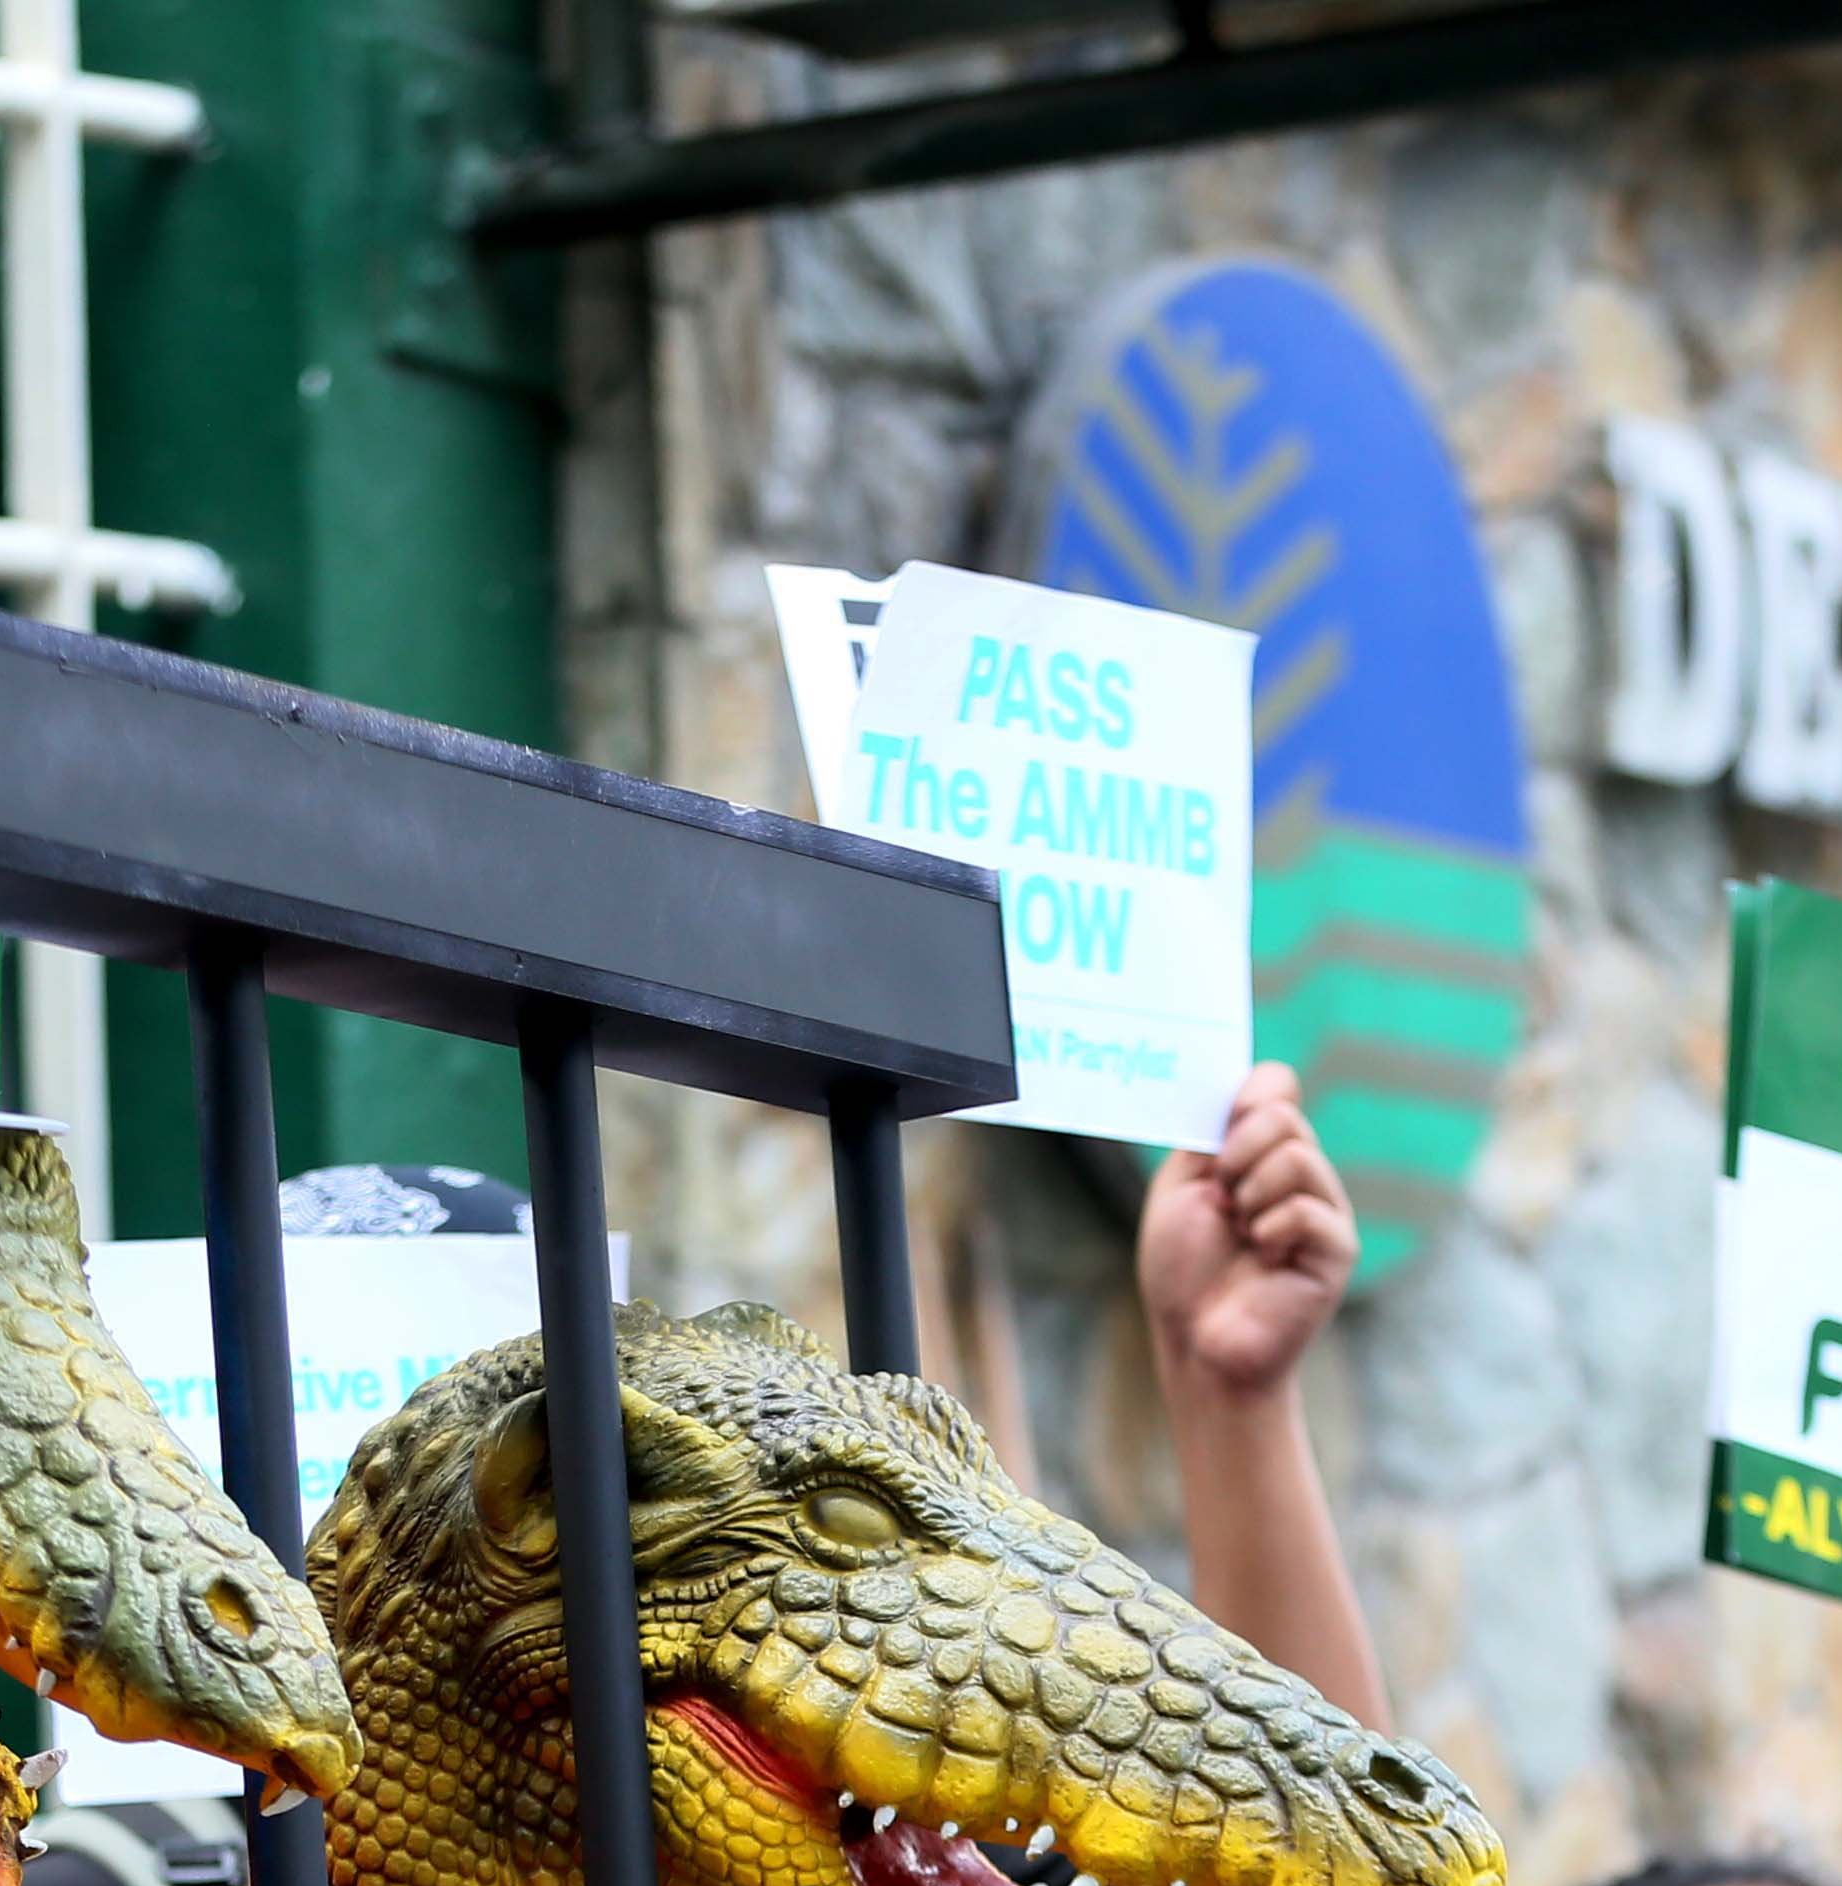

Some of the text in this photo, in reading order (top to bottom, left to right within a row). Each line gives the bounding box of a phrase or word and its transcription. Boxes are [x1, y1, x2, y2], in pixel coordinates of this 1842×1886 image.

[957, 634, 1136, 750] PASS
[860, 730, 1218, 877] The AMMB
[1001, 870, 1133, 976] OW
